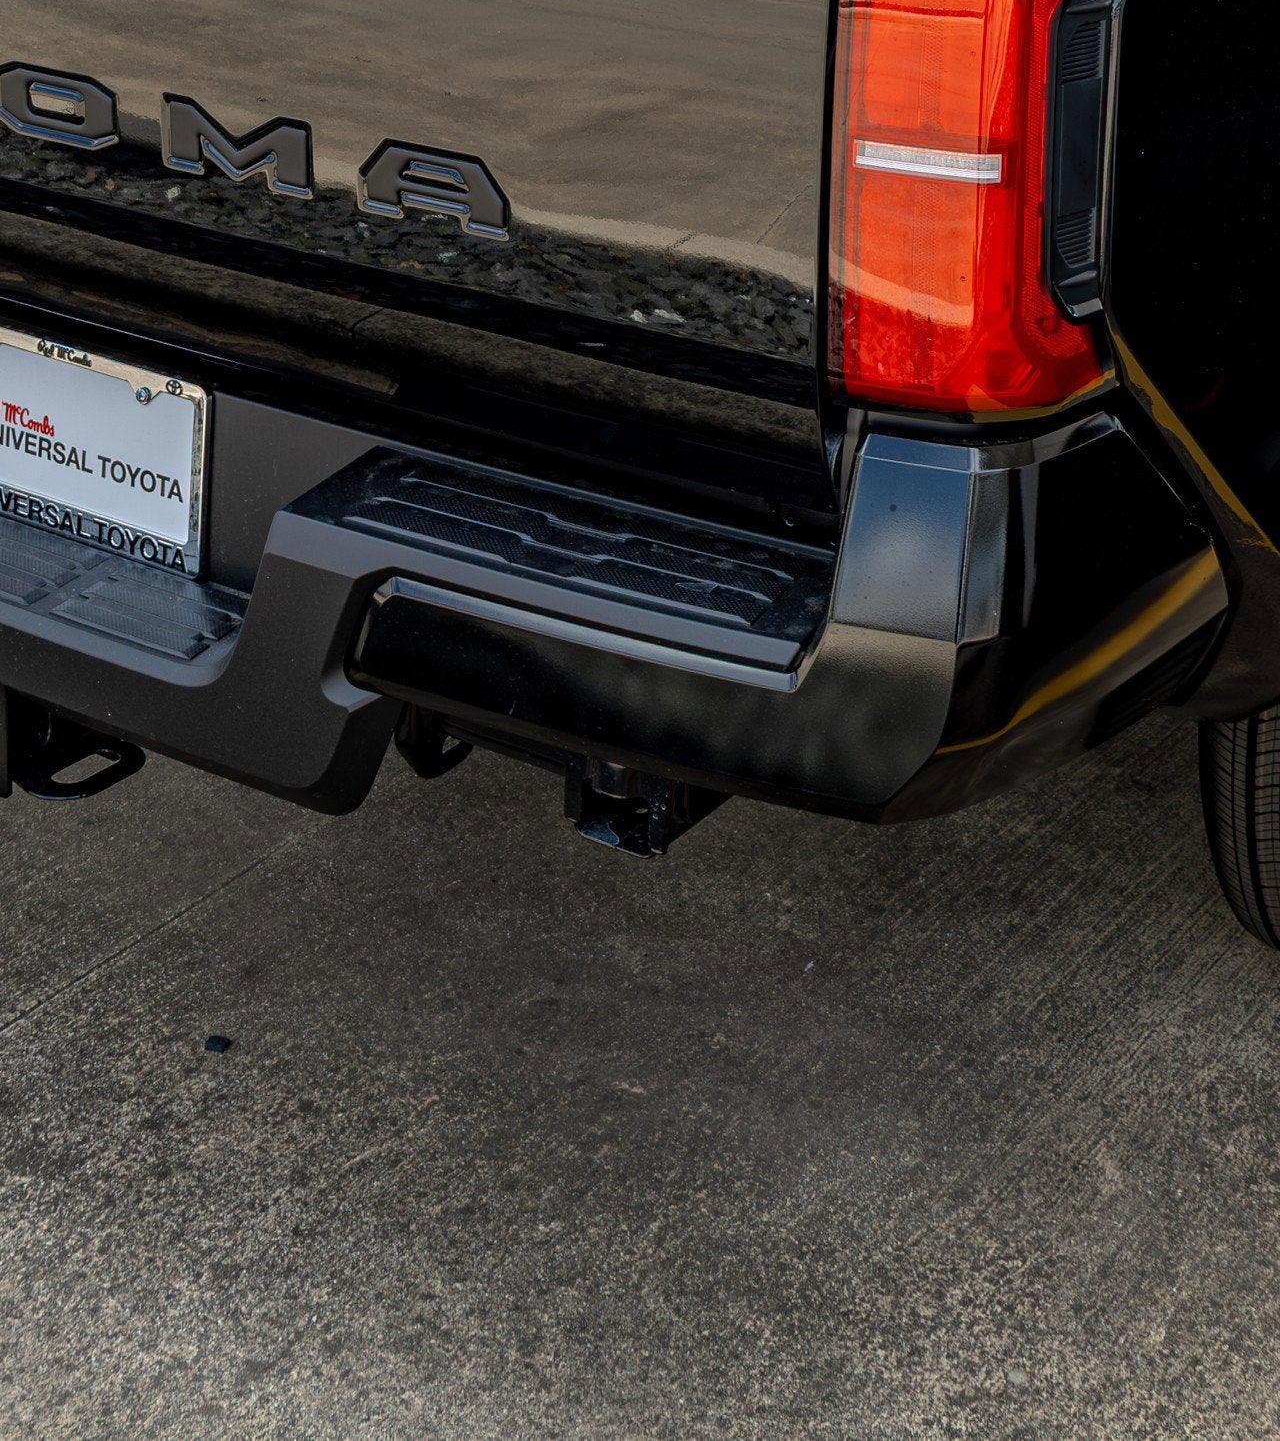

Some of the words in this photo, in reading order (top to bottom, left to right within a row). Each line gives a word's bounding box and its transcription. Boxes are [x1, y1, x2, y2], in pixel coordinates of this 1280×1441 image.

[1, 399, 55, 437] McCombs
[97, 454, 184, 504] TOYOTA
[93, 520, 189, 575] TOYOTA
